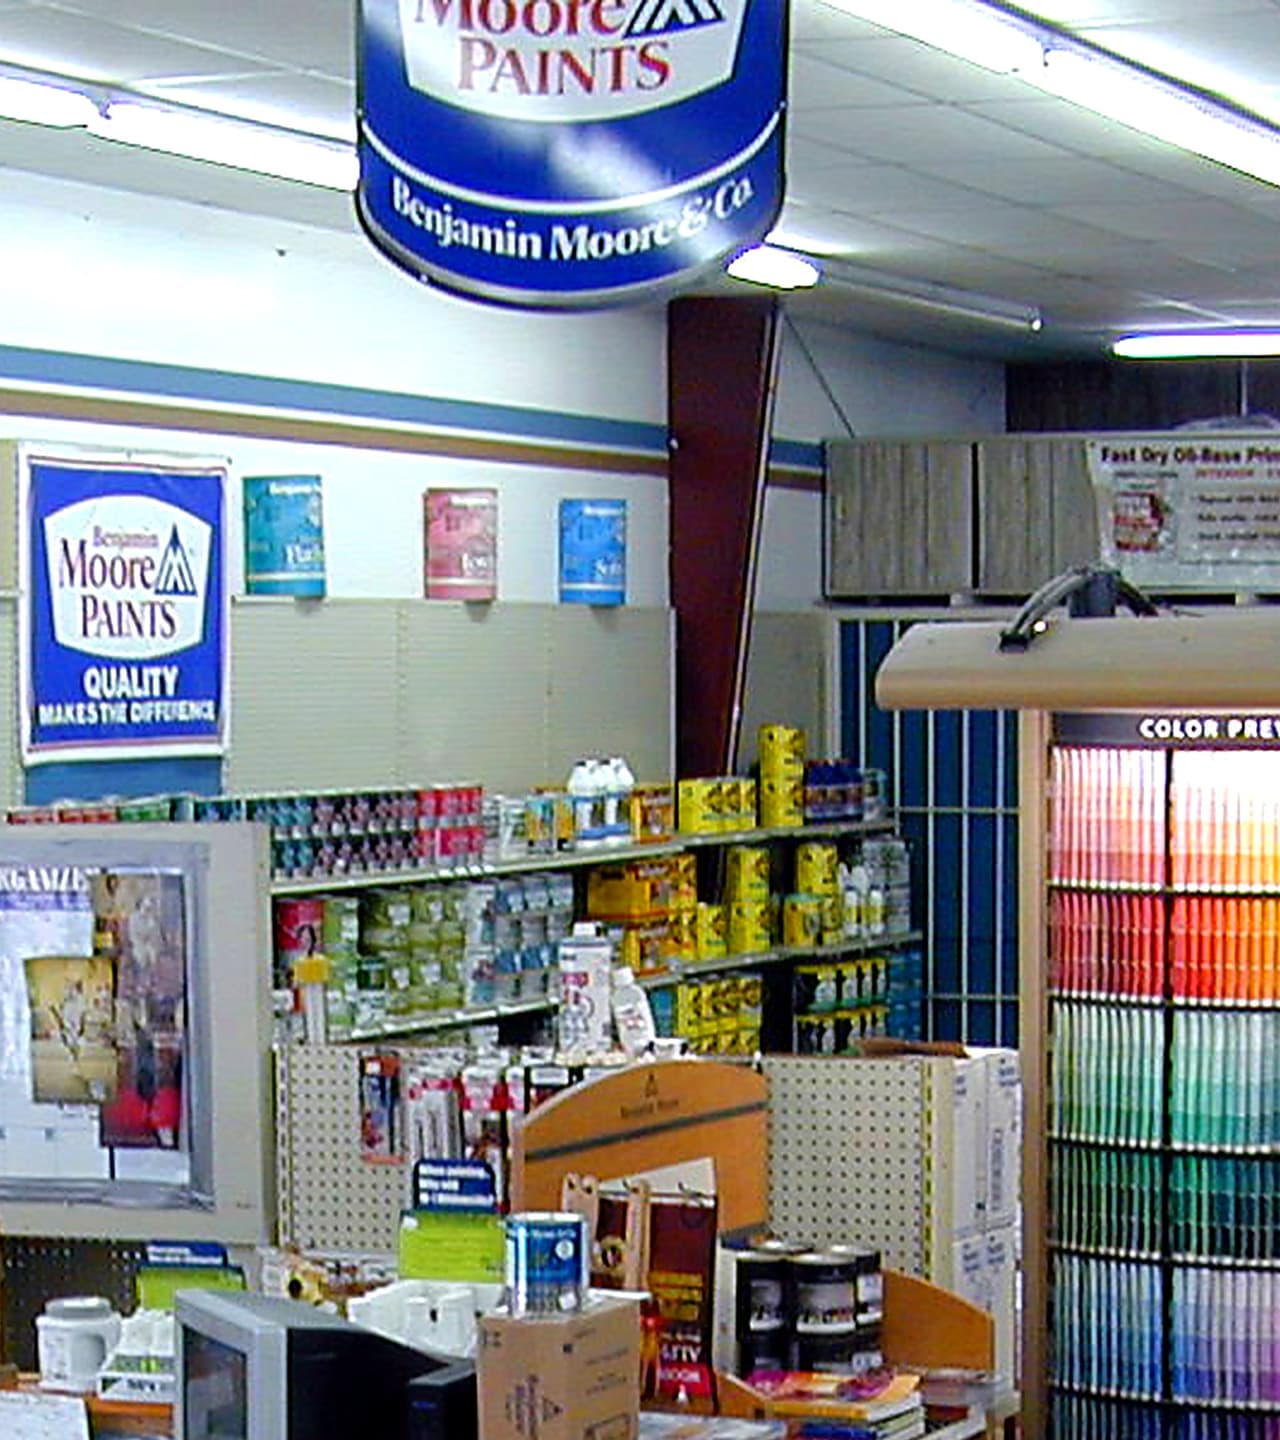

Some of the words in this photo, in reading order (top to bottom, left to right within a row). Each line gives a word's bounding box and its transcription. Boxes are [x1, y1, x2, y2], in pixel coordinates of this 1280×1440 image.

[458, 41, 671, 96] PAINTS
[391, 177, 542, 260] Benjamin
[550, 206, 674, 260] Moore
[58, 537, 156, 590] Moore
[81, 593, 177, 639] PAINTS
[82, 665, 179, 699] QUALITY
[37, 701, 96, 727] MAKES
[98, 701, 128, 724] THE
[129, 699, 216, 723] DIFFERENCE
[1139, 718, 1218, 740] COLOR
